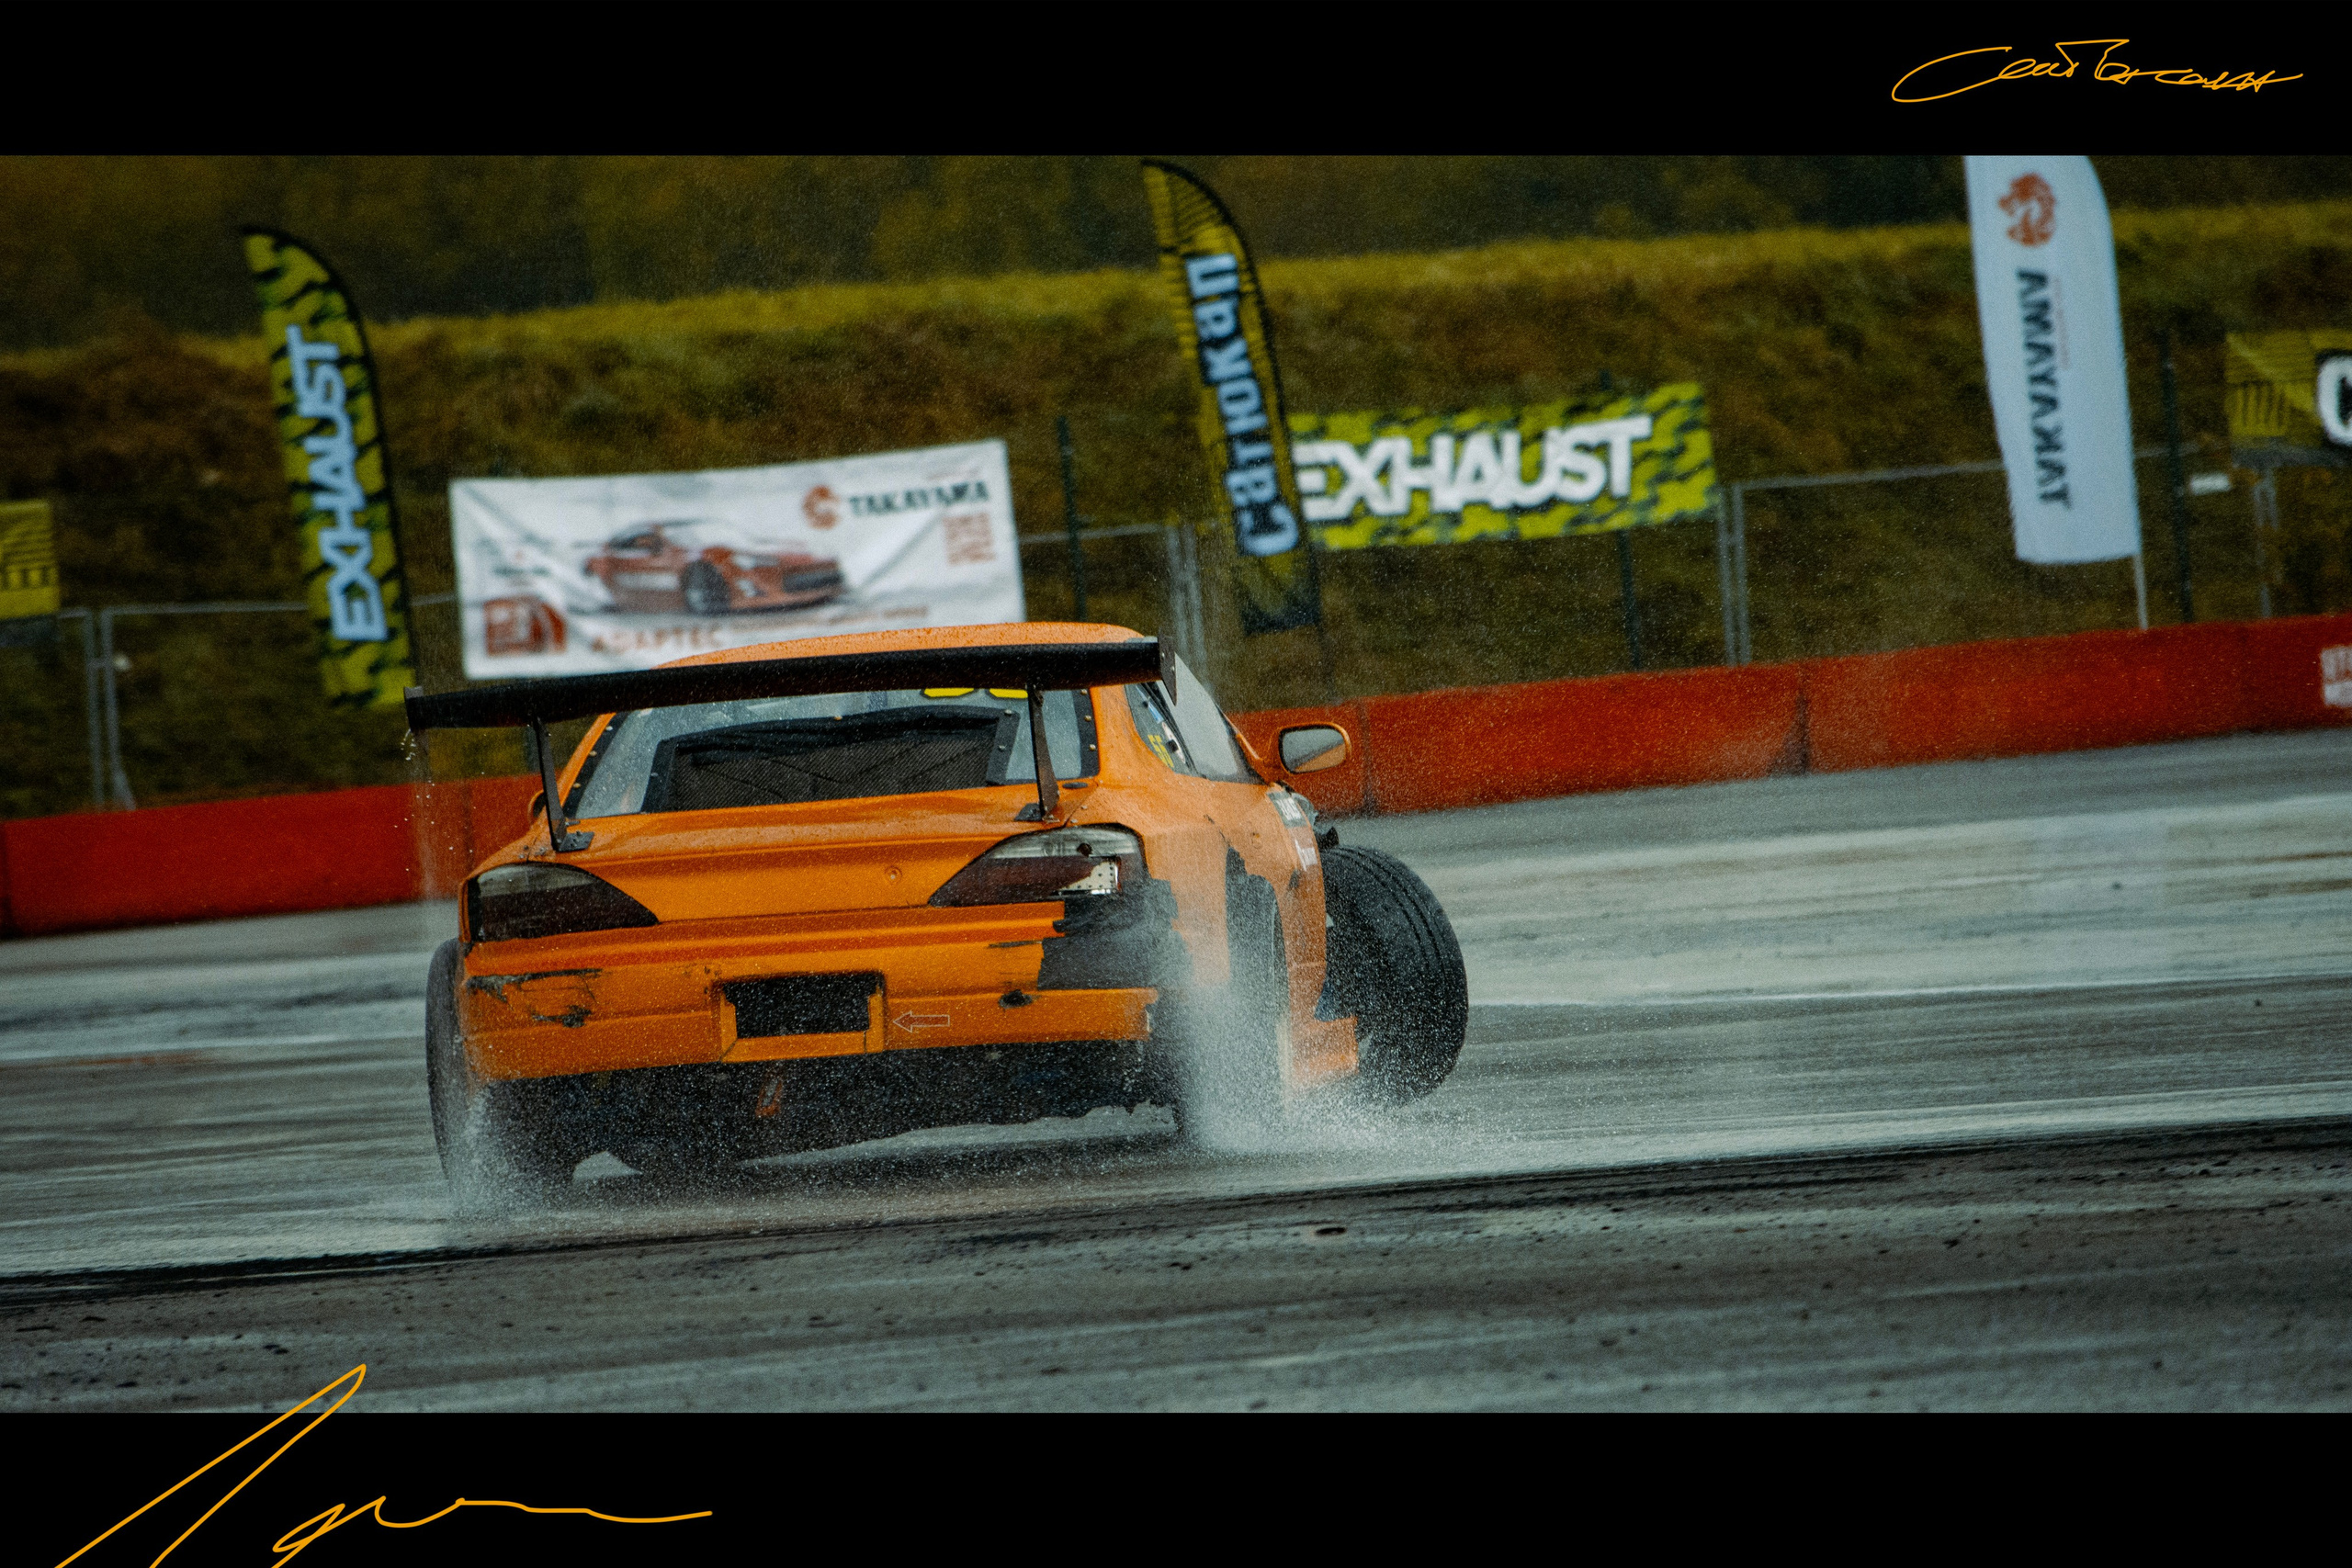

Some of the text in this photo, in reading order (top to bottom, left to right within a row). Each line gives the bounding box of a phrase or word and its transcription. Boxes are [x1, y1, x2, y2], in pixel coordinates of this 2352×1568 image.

[286, 324, 387, 640] EXHAUST
[849, 480, 989, 517] TAKAYAMA
[1291, 414, 1653, 521] EXHAUST
